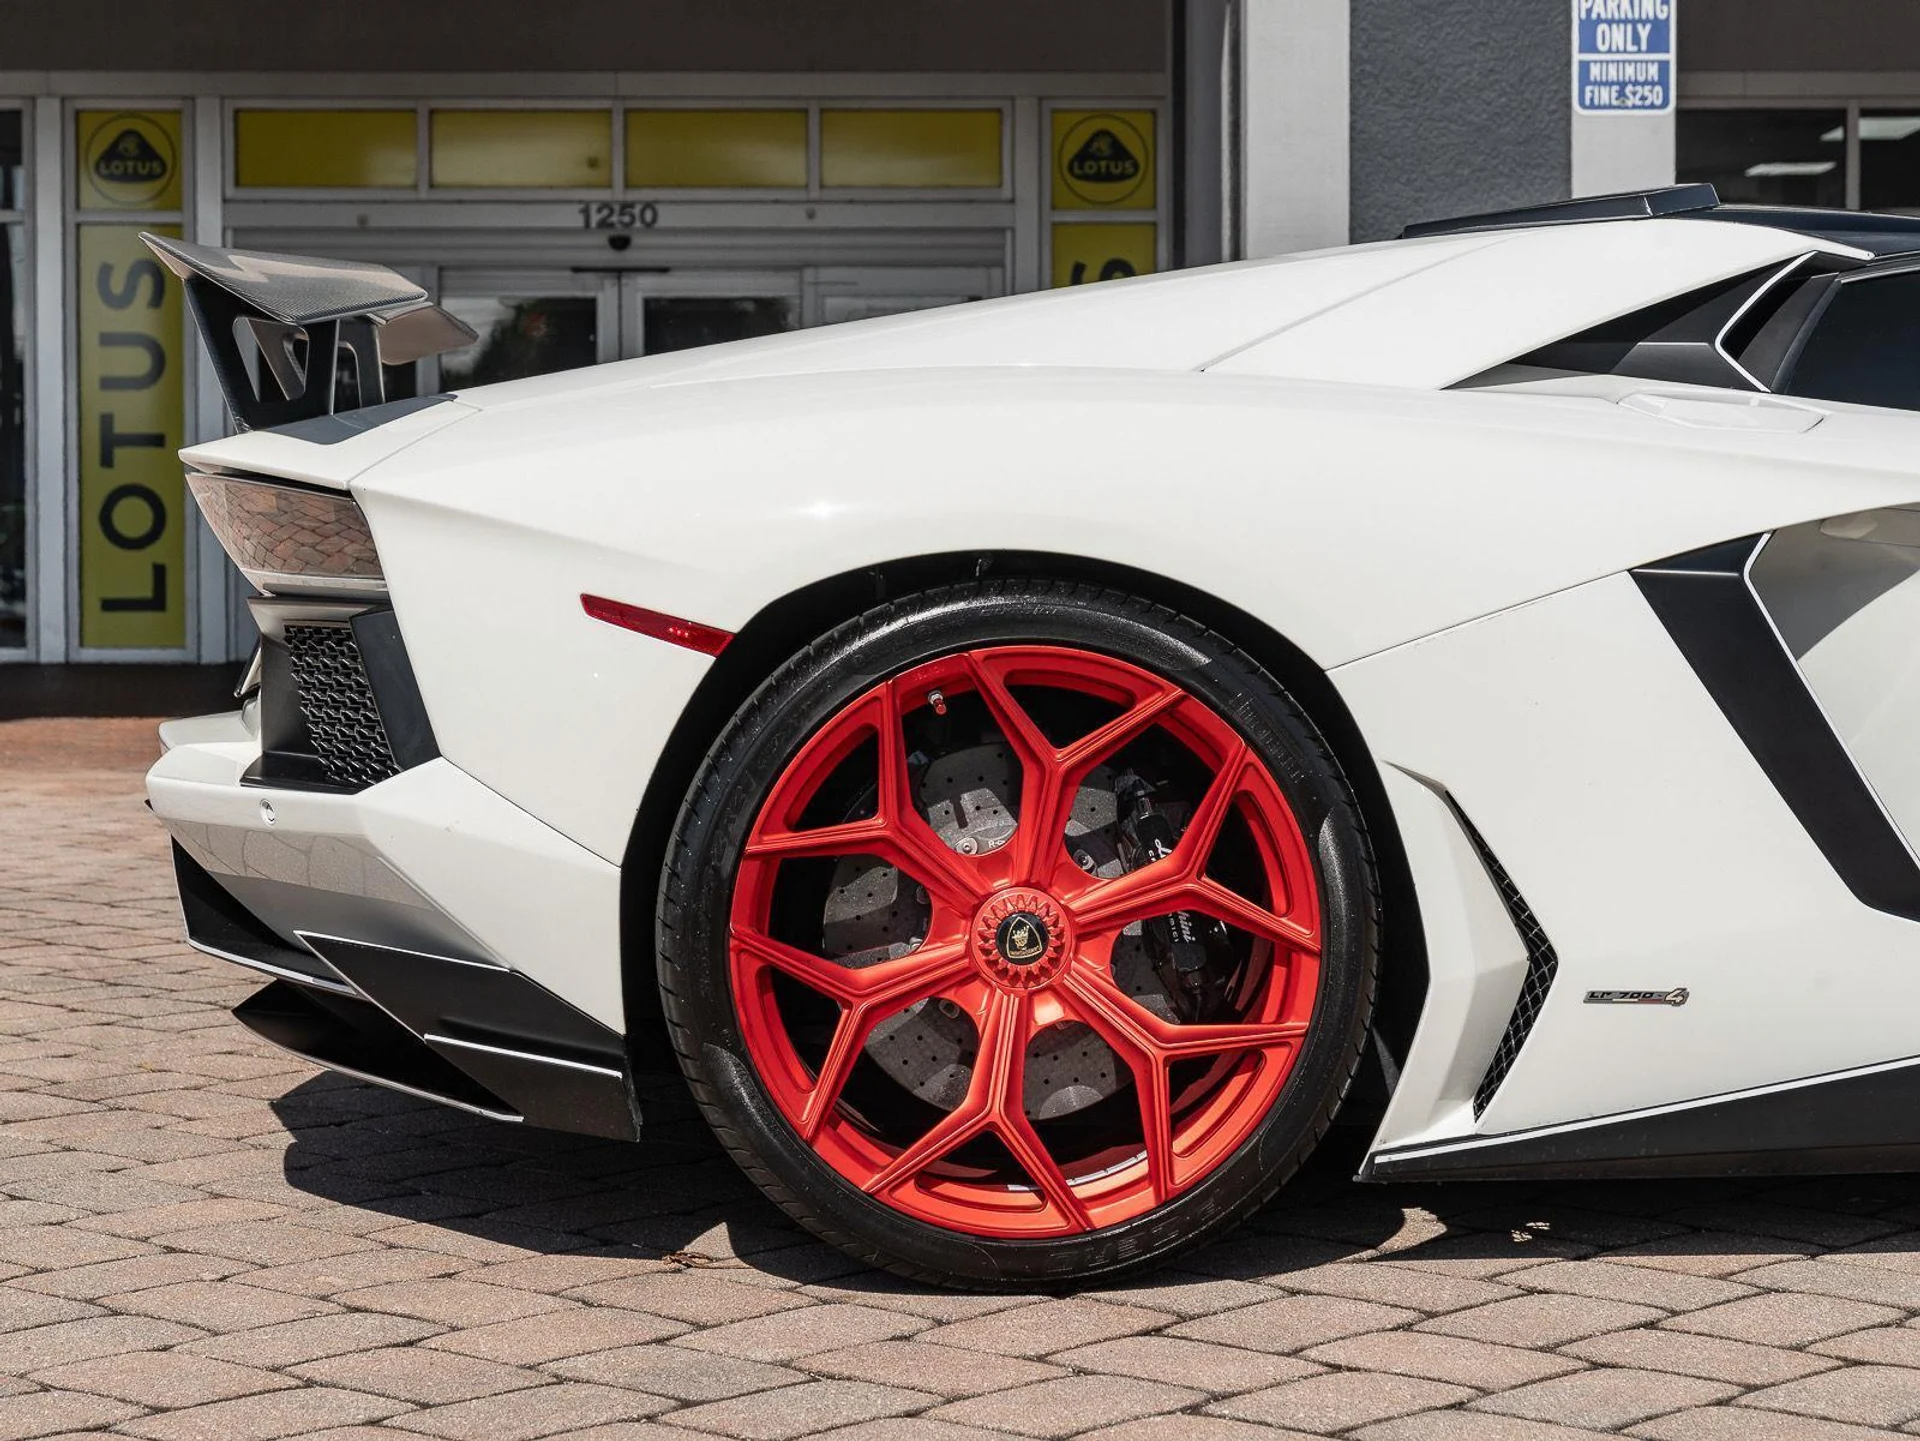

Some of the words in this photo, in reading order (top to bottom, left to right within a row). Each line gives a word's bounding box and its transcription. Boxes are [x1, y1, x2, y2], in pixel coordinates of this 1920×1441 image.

[1579, 0, 1669, 20] PARKING
[1596, 23, 1652, 52] ONLY
[1589, 62, 1659, 82] MINIMUM
[1584, 85, 1619, 106] FINE
[1624, 84, 1663, 107] $250
[100, 160, 162, 174] LOTUS
[1073, 159, 1136, 174] LOTUS
[578, 203, 658, 229] 1250
[98, 257, 167, 613] LOTUS
